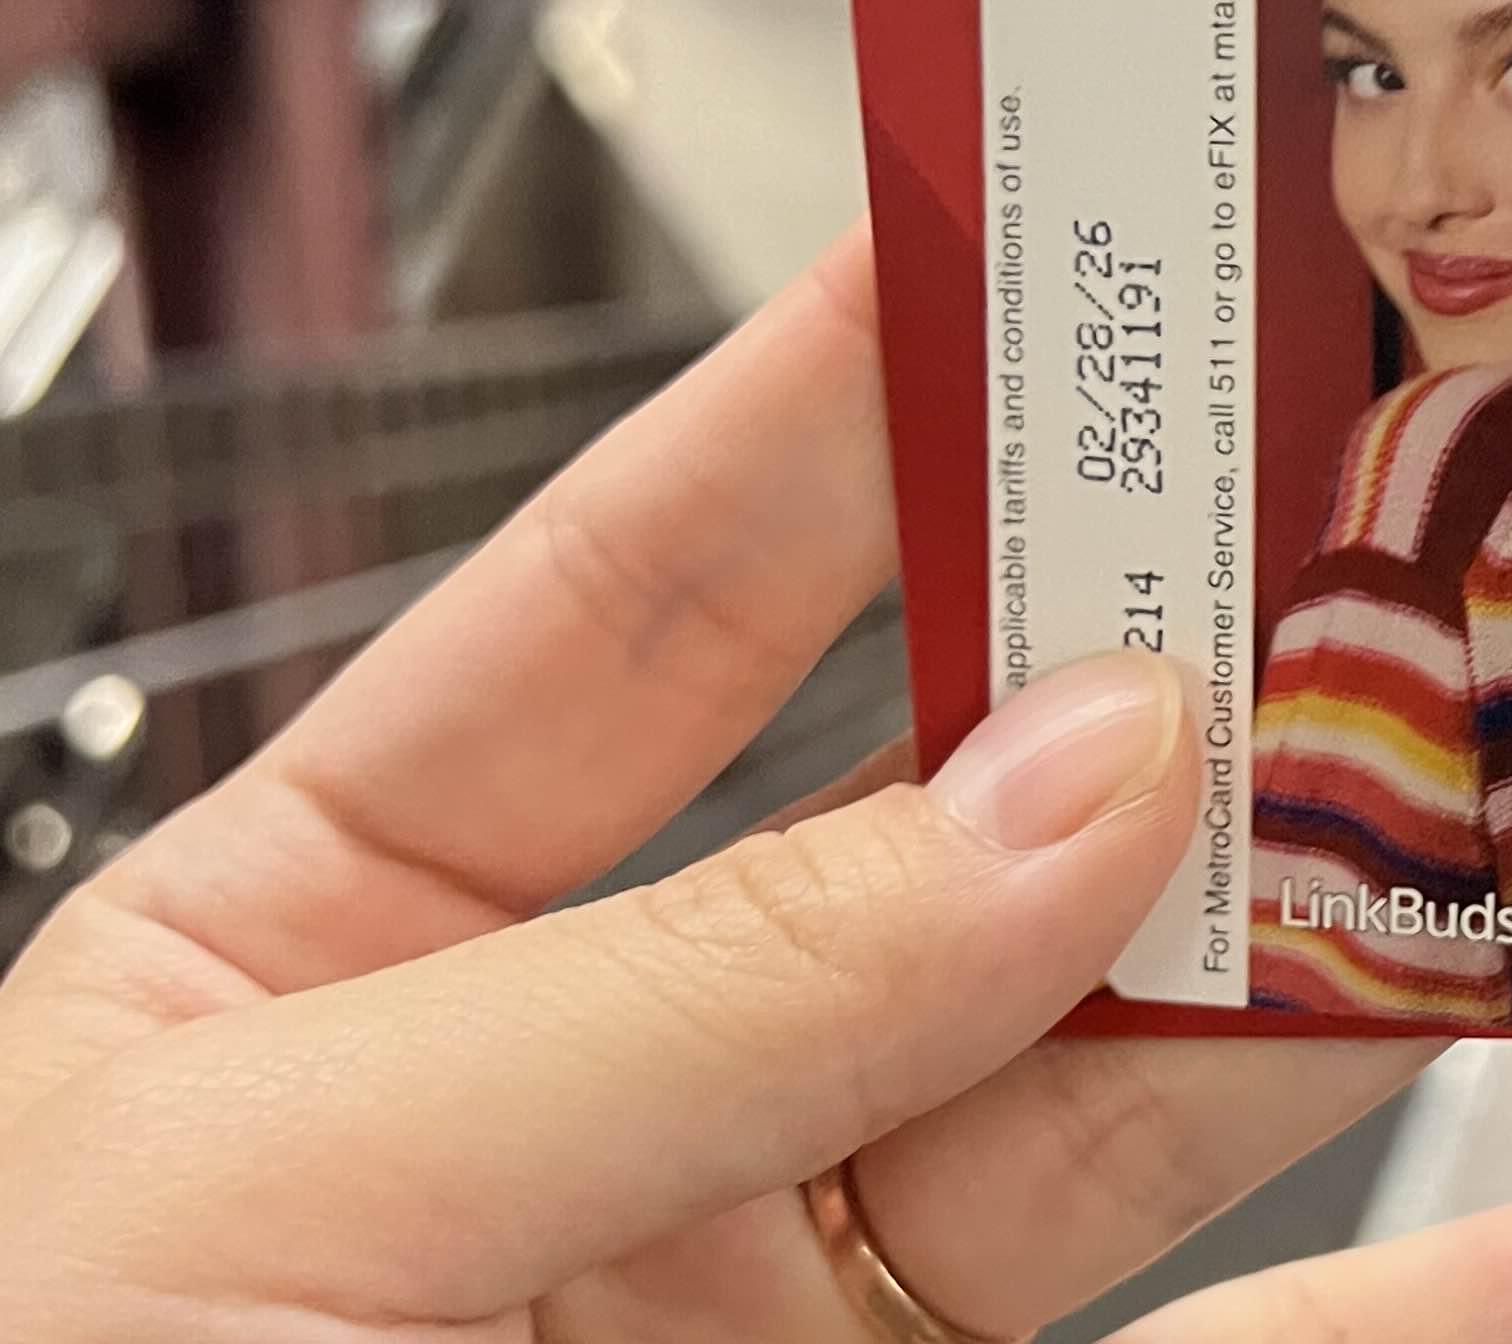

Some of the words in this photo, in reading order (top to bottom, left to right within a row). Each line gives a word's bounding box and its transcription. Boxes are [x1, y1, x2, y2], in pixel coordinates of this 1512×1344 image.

[998, 86, 1023, 152] use.
[1210, 74, 1236, 103] at
[992, 161, 1022, 193] of
[1208, 113, 1236, 190] eFIX
[1210, 201, 1236, 230] to
[994, 203, 1025, 363] conditions
[1213, 242, 1243, 282] go
[1213, 291, 1236, 323] or
[1073, 218, 1116, 483] 02/28/26
[1118, 258, 1163, 495] 29341191
[1208, 337, 1236, 393] 511
[998, 374, 1025, 431] and
[1208, 403, 1236, 456] call
[997, 442, 1026, 524] tariffs
[1207, 467, 1239, 591] Service,
[998, 535, 1032, 688] applicable
[1205, 600, 1235, 748] Customer
[1203, 758, 1234, 916] MetroCard
[1203, 925, 1231, 974] For
